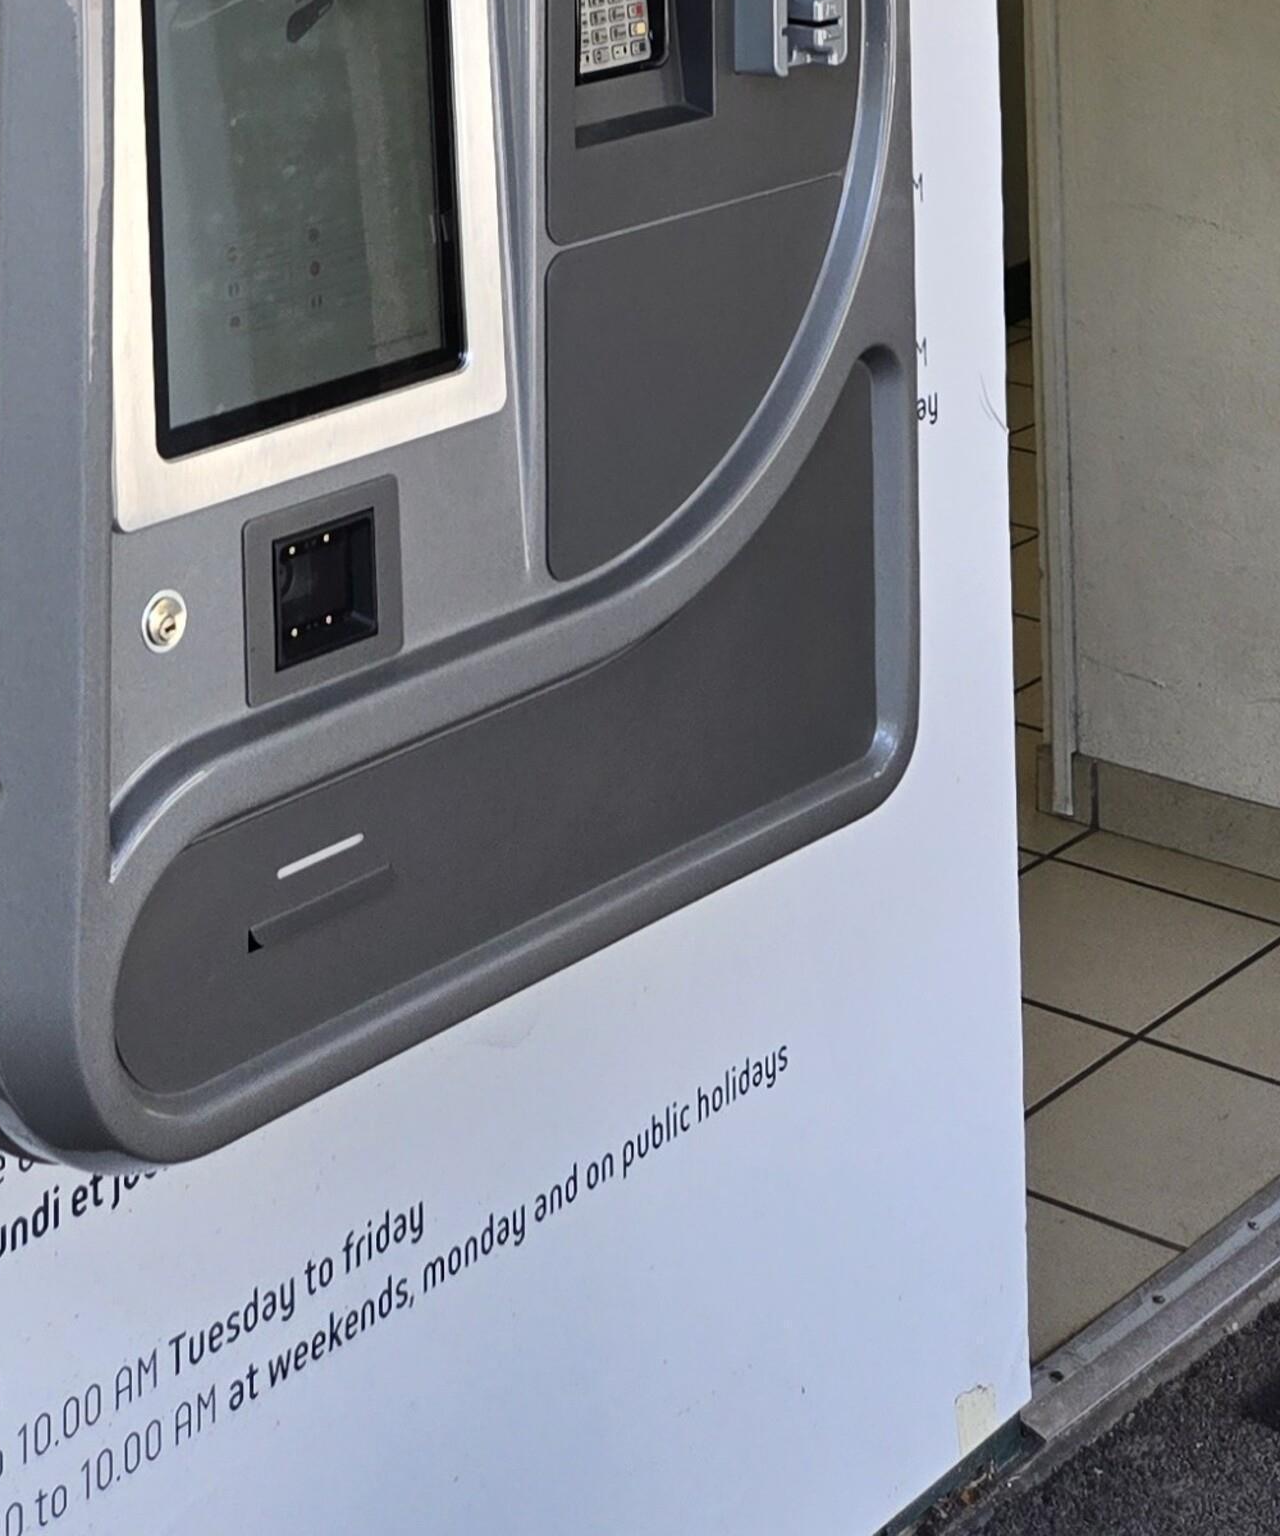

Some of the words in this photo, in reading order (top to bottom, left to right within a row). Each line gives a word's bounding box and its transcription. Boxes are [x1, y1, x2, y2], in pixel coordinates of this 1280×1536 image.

[34, 1485, 68, 1527] to
[80, 1419, 162, 1501] 10.00
[174, 1383, 217, 1446] AM
[228, 1362, 259, 1412] at
[268, 1274, 415, 1388] weekends,
[422, 1204, 526, 1294] monday
[534, 1163, 578, 1223] and
[585, 1151, 615, 1191] on
[622, 1101, 691, 1180] public
[696, 1044, 789, 1124] holidays
[71, 1174, 104, 1218] et
[17, 1382, 102, 1465] 10.00
[115, 1347, 158, 1411] AM
[168, 1276, 296, 1377] Tuesday
[304, 1256, 334, 1296] to
[342, 1200, 424, 1275] friday
